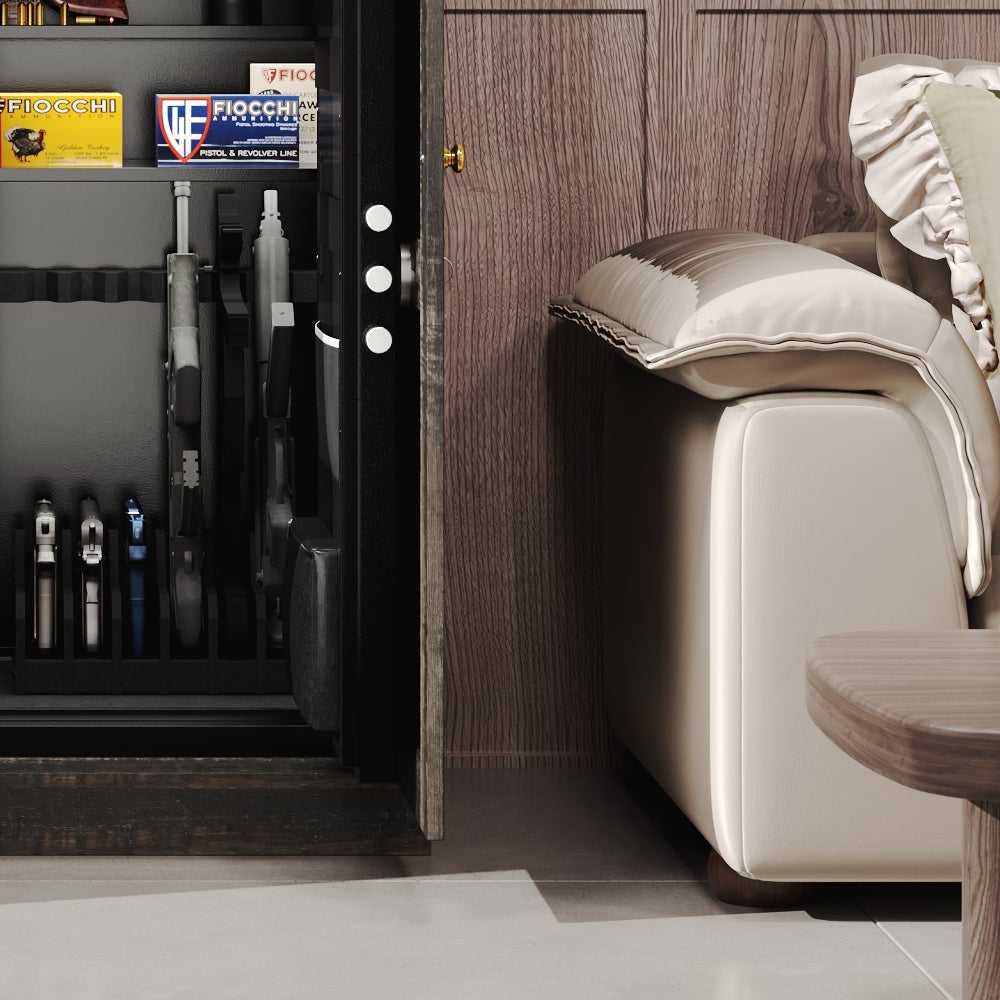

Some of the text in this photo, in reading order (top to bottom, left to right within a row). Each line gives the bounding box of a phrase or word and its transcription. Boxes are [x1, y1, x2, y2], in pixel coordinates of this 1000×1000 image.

[7, 99, 117, 114] FIOCCHI
[212, 100, 298, 116] FIOCCHI
[300, 101, 317, 109] AW
[200, 149, 227, 157] PISTOL
[229, 149, 236, 157] &
[238, 149, 277, 157] REVOLVER
